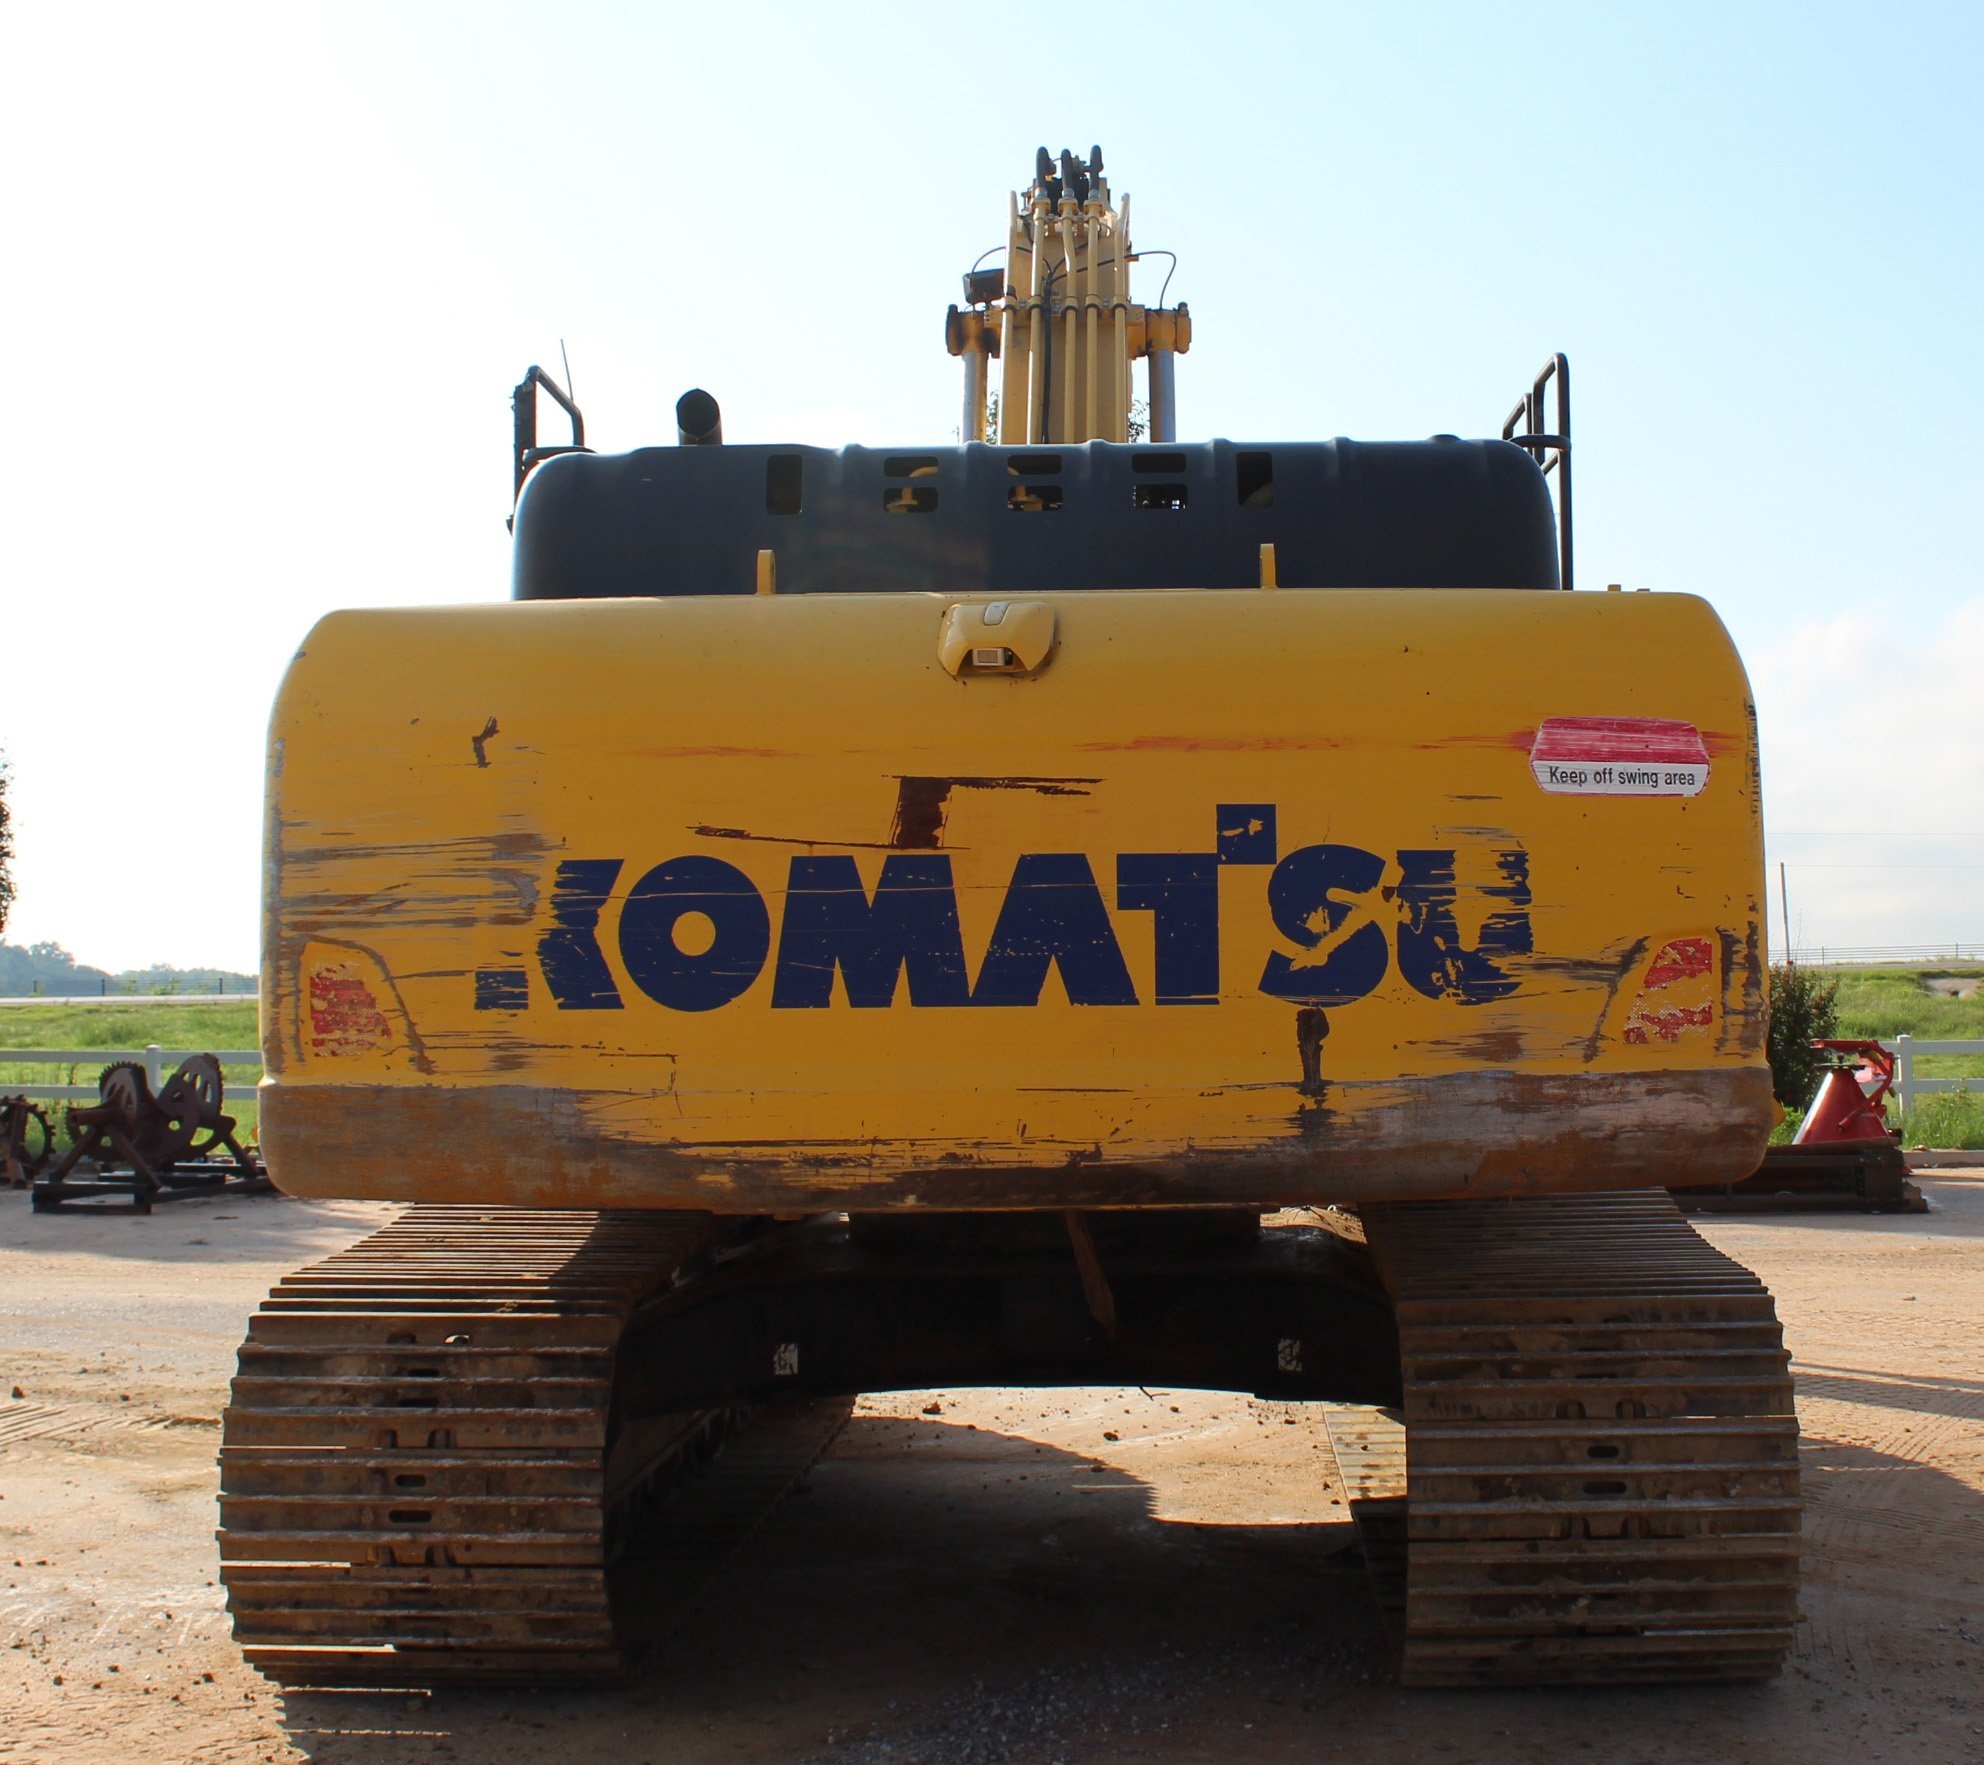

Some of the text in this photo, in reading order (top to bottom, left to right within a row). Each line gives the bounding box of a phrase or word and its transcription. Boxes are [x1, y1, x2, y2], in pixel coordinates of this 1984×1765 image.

[1549, 766, 1695, 787] Keep off swing area
